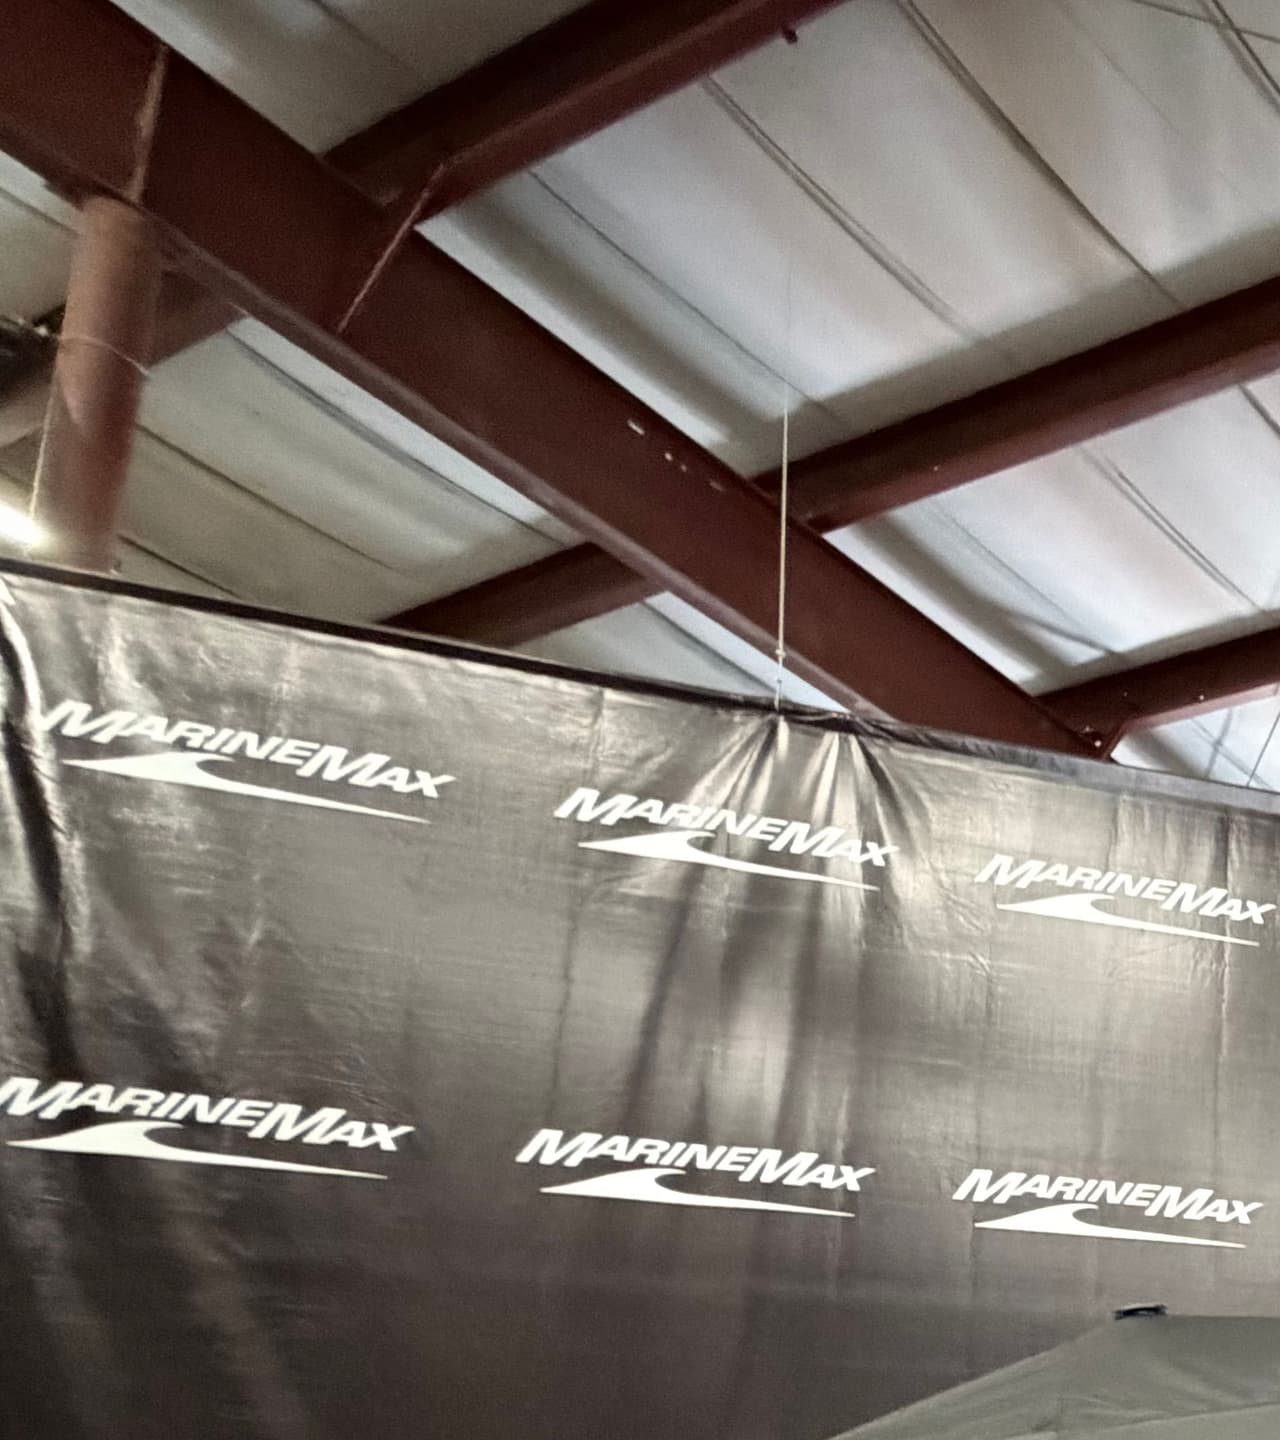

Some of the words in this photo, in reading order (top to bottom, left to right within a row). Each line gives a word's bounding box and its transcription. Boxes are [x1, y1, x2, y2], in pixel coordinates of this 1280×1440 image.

[38, 700, 456, 800] MARINEMAX
[553, 786, 898, 868] MARINEMAX
[975, 853, 1277, 925] MARINEMAX
[0, 1077, 415, 1153] MARINEMAX
[516, 1128, 876, 1192] MARINEMAX
[952, 1168, 1263, 1226] MARINEMAX
